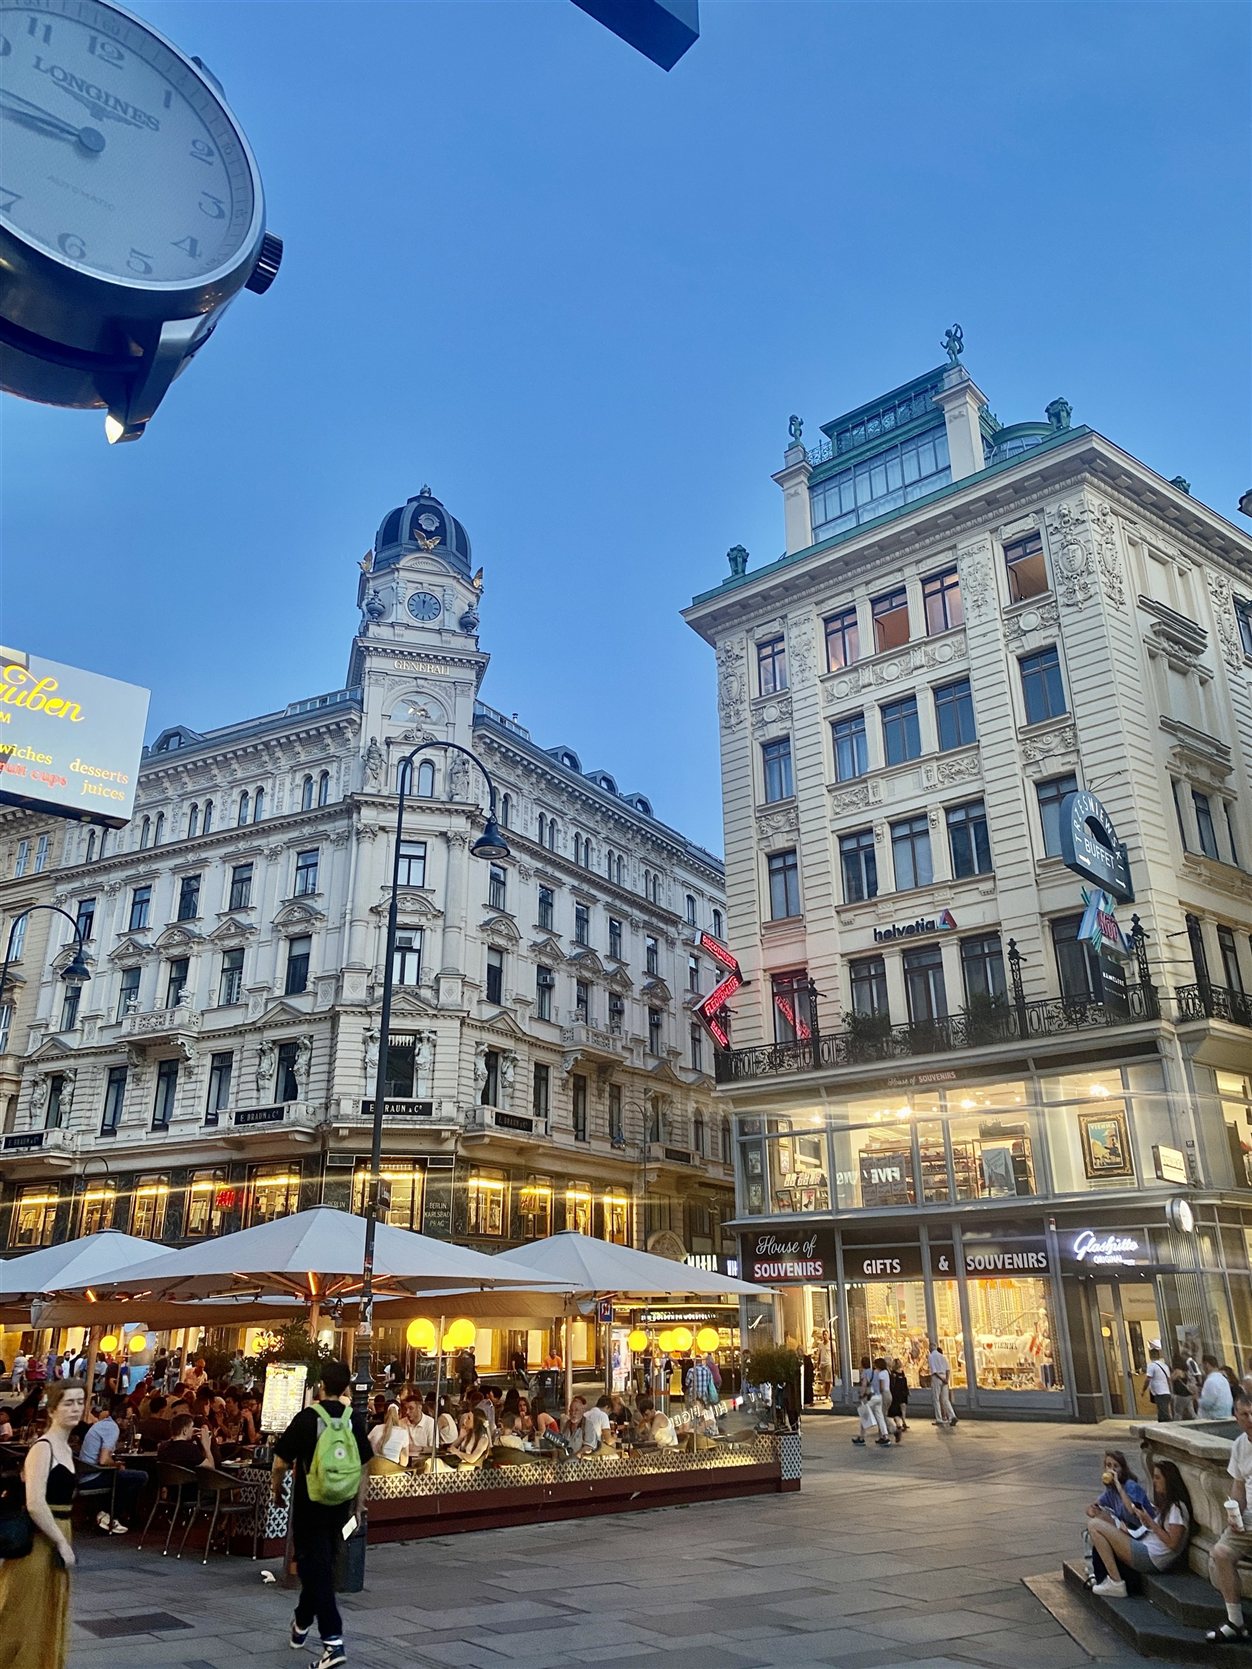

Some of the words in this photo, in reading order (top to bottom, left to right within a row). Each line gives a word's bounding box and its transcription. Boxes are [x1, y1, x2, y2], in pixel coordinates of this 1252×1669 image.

[27, 16, 52, 46] 11
[89, 35, 125, 70] 12
[33, 56, 160, 132] LONGINES
[163, 90, 172, 109] 1
[189, 138, 215, 166] 2
[198, 191, 225, 220] 3
[57, 233, 87, 260] 6
[171, 235, 200, 260] 4
[126, 248, 153, 275] 5
[394, 660, 450, 675] GENERALI
[30, 770, 67, 788] cups
[69, 758, 129, 785] desserts
[81, 780, 126, 801] juices
[1084, 837, 1115, 870] BUFFET
[873, 918, 935, 941] helvetia
[704, 977, 740, 1017] FLEDERMAUS
[887, 1076, 908, 1087] House
[909, 1075, 917, 1086] of
[918, 1071, 957, 1083] SOUVENIRS
[384, 1104, 406, 1113] RAUN
[756, 1235, 800, 1256] House
[803, 1234, 817, 1258] of
[754, 1261, 823, 1278] SOUVENIRS
[863, 1258, 901, 1275] GIFTS
[938, 1255, 949, 1271] &
[966, 1252, 1047, 1271] SOUVENIRS
